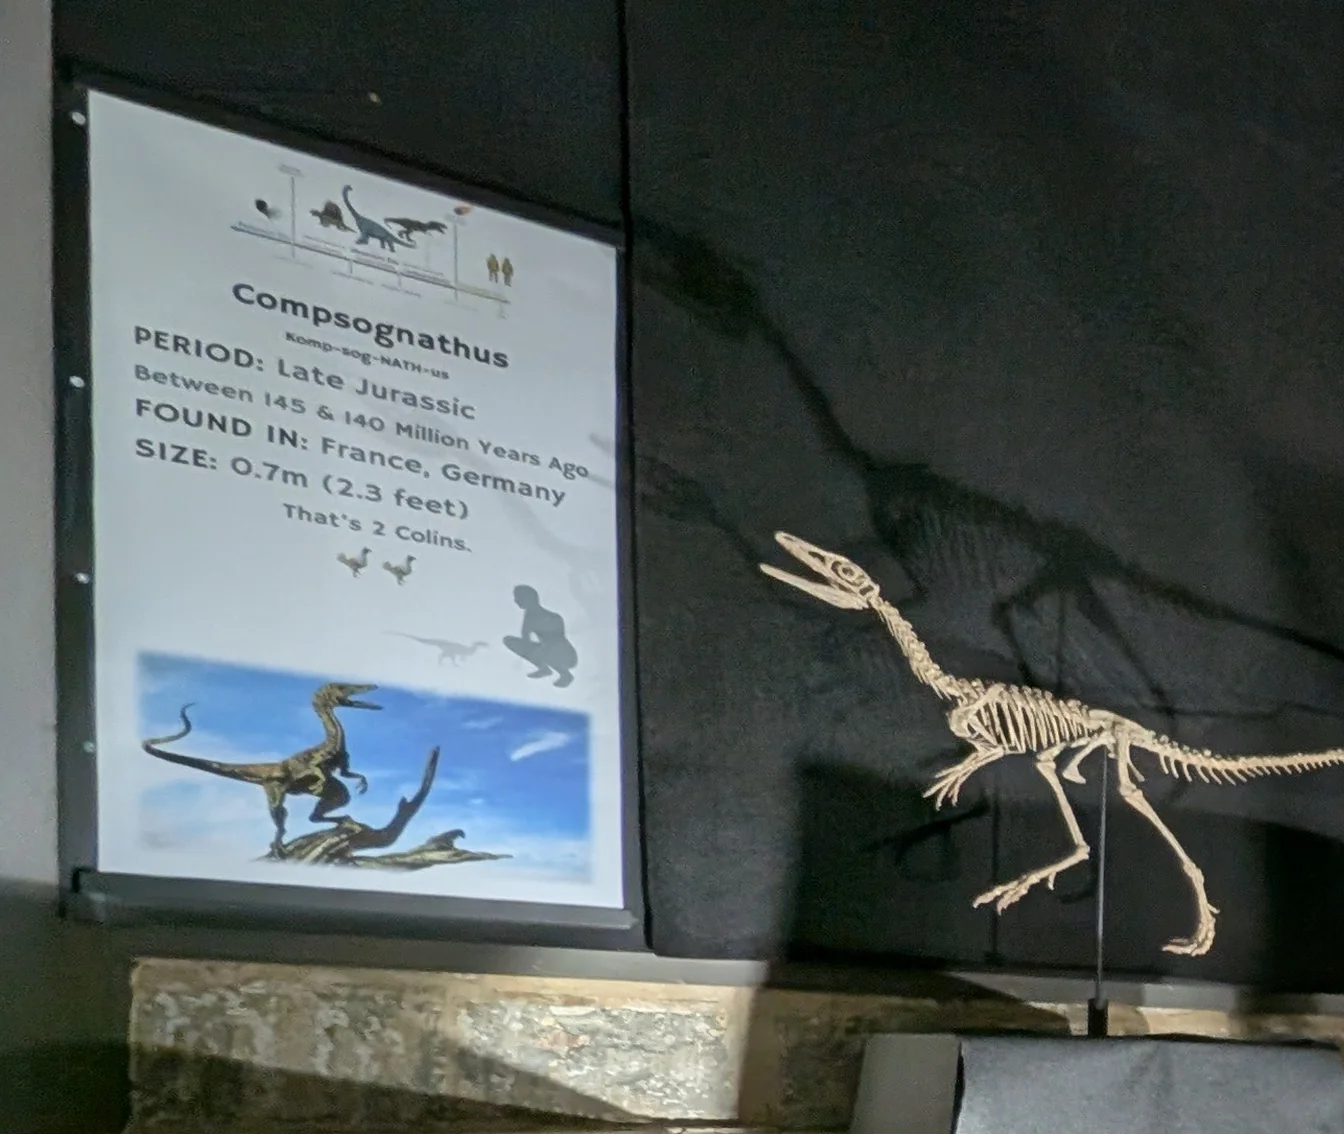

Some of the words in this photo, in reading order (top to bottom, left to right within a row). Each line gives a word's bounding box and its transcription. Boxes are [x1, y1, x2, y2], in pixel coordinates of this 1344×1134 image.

[232, 283, 509, 369] Compsognathus
[285, 331, 449, 380] Komp-sog-NATH-us
[134, 325, 264, 372] PERIOD:
[278, 358, 345, 391] Late
[355, 378, 475, 420] Jurassic
[134, 364, 254, 403] Between
[265, 392, 307, 415] 145
[316, 404, 335, 422] &
[344, 410, 385, 433] 140
[396, 422, 469, 451] Million
[479, 439, 541, 467] Years
[548, 457, 589, 480] Ago
[135, 398, 252, 437] FOUND
[267, 424, 308, 451] IN:
[321, 436, 430, 478] France,
[441, 462, 566, 506] Germany
[135, 438, 218, 470] SIZE:
[231, 456, 308, 488] 0.7m
[322, 474, 382, 503] (2.3
[394, 487, 469, 520] feet)
[283, 501, 362, 532] That's
[372, 519, 386, 536] 2
[395, 523, 472, 553] Colins.
